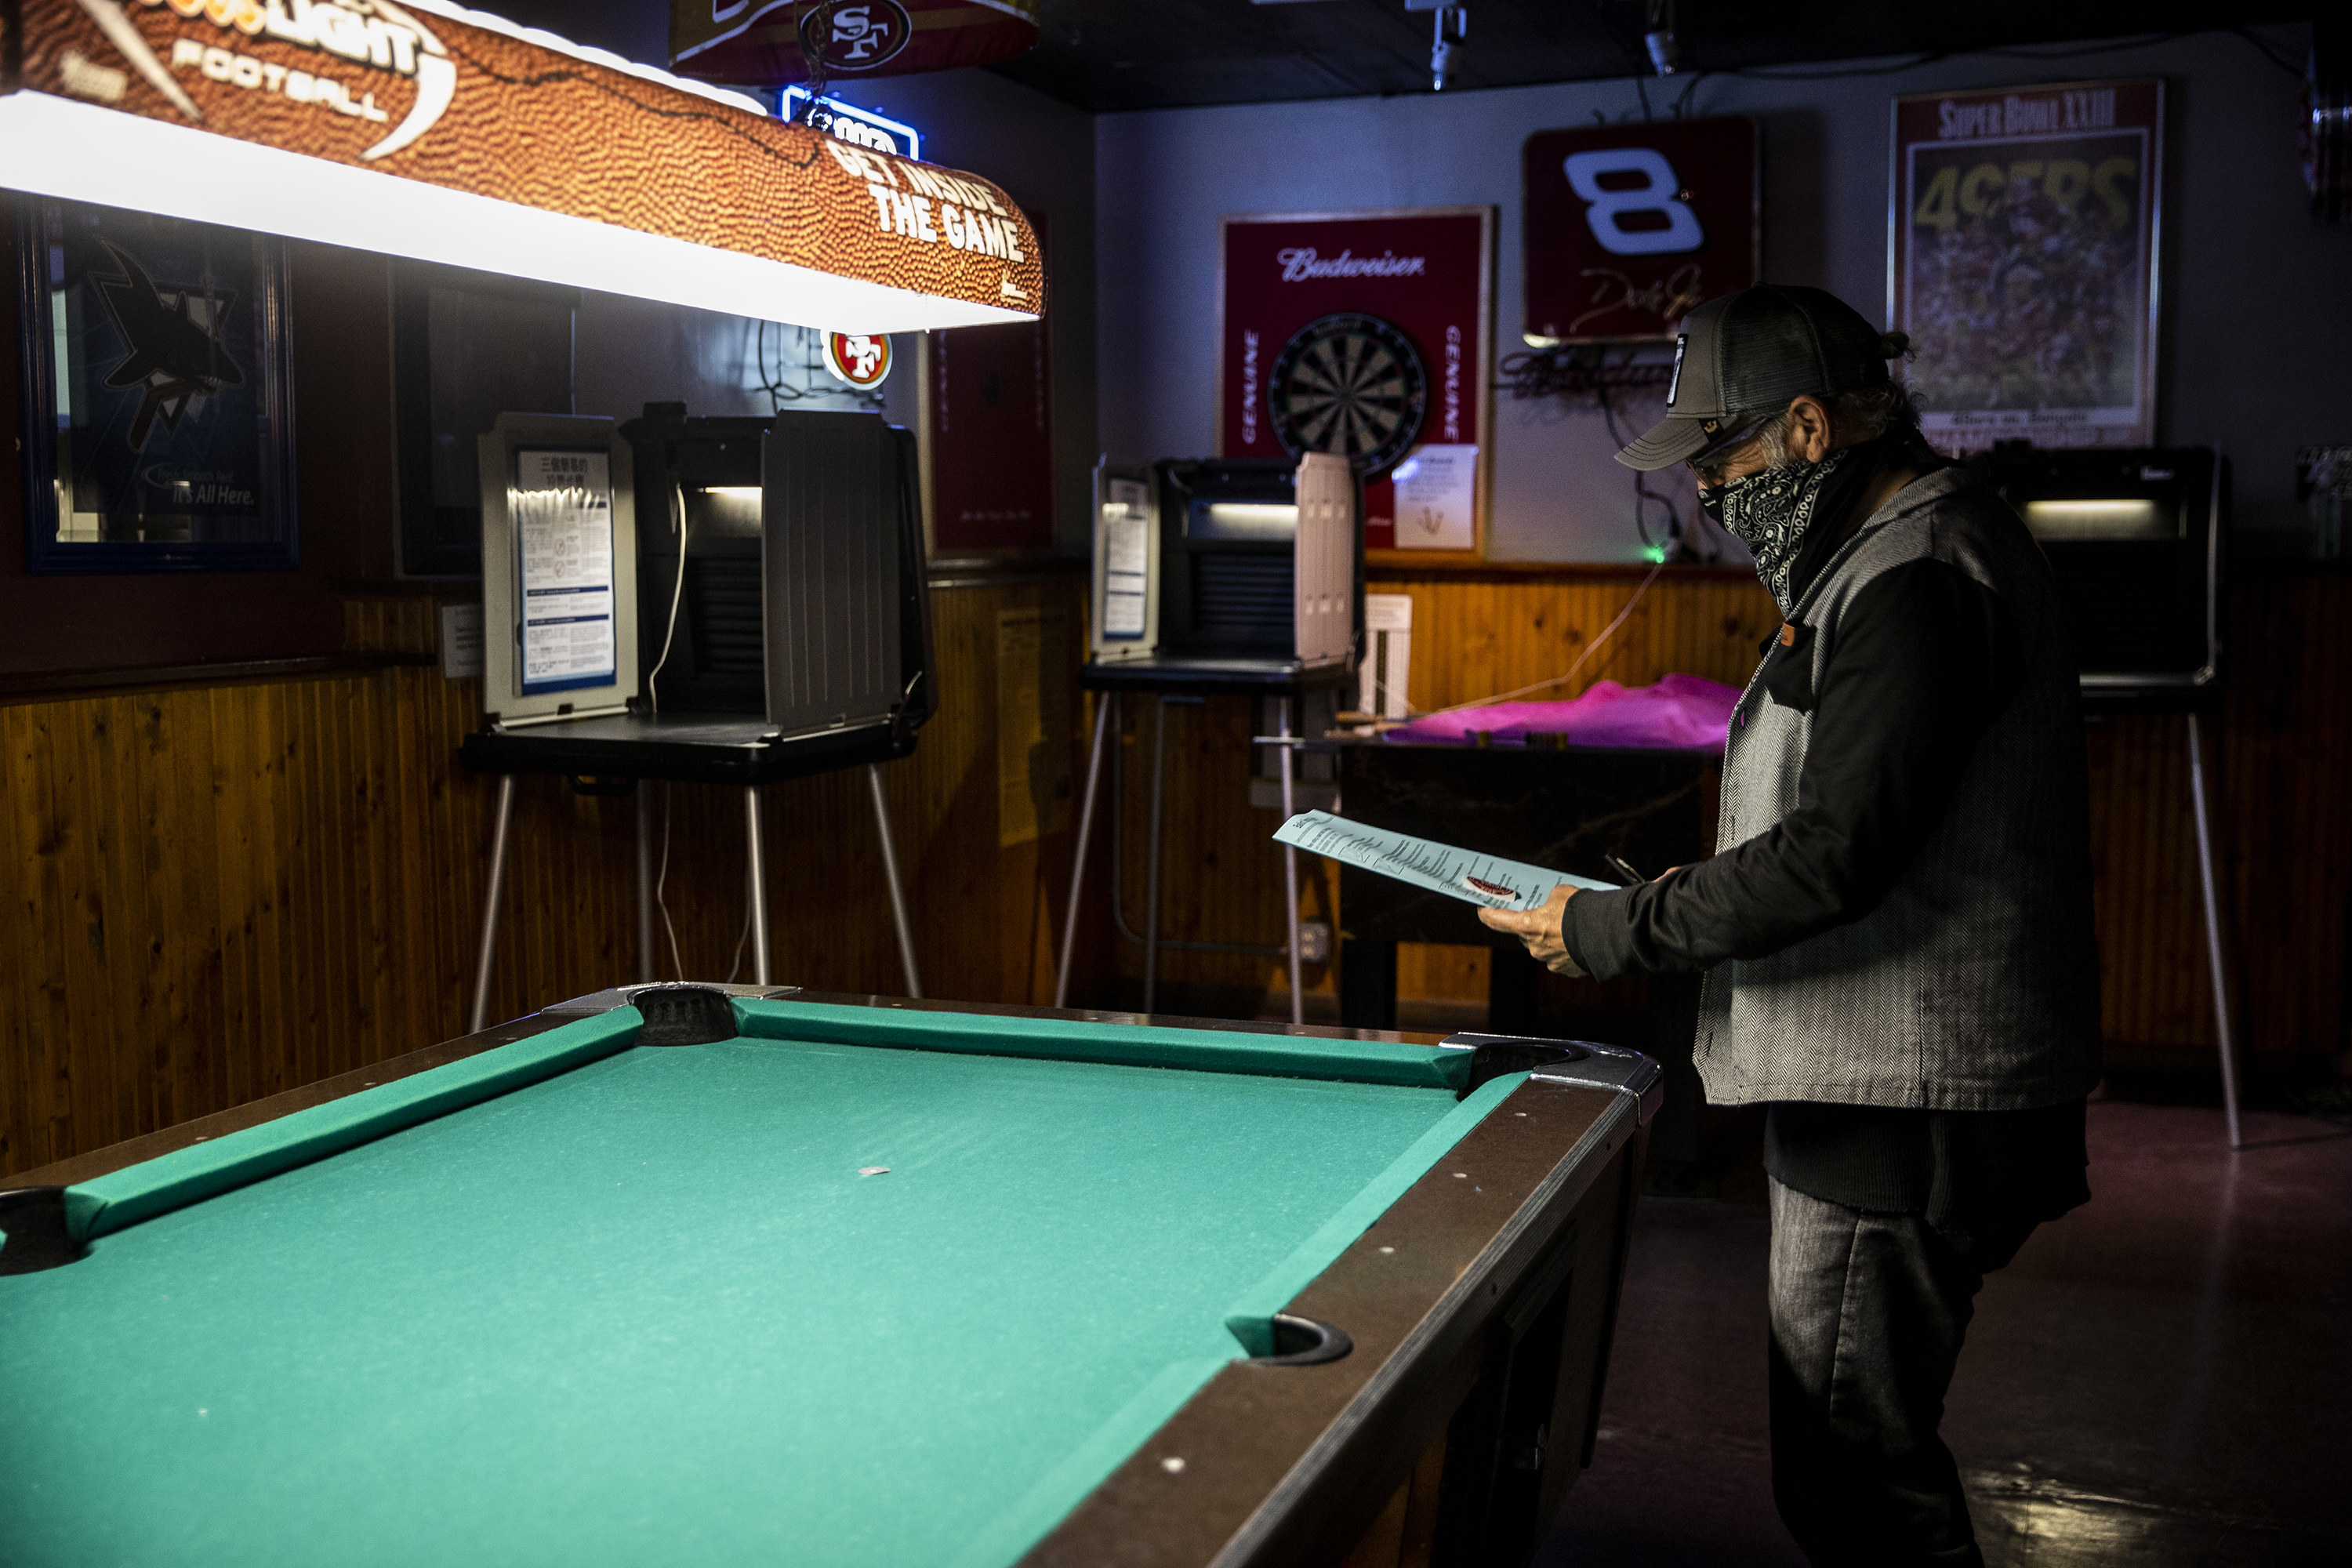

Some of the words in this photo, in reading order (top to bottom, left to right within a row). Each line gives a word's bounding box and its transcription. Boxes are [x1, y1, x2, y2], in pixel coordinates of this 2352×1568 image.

[172, 38, 389, 123] FOOTBALL
[825, 140, 902, 187] GET
[898, 160, 1008, 216] INSIDE
[1563, 147, 1705, 256] 8
[868, 183, 937, 244] THE
[942, 198, 1025, 263] GAME
[1276, 246, 1427, 282] Budweiser
[1242, 328, 1259, 444] GENUINE
[1444, 325, 1461, 443] GENUINE
[194, 484, 216, 505] All
[216, 485, 255, 506] Here.
